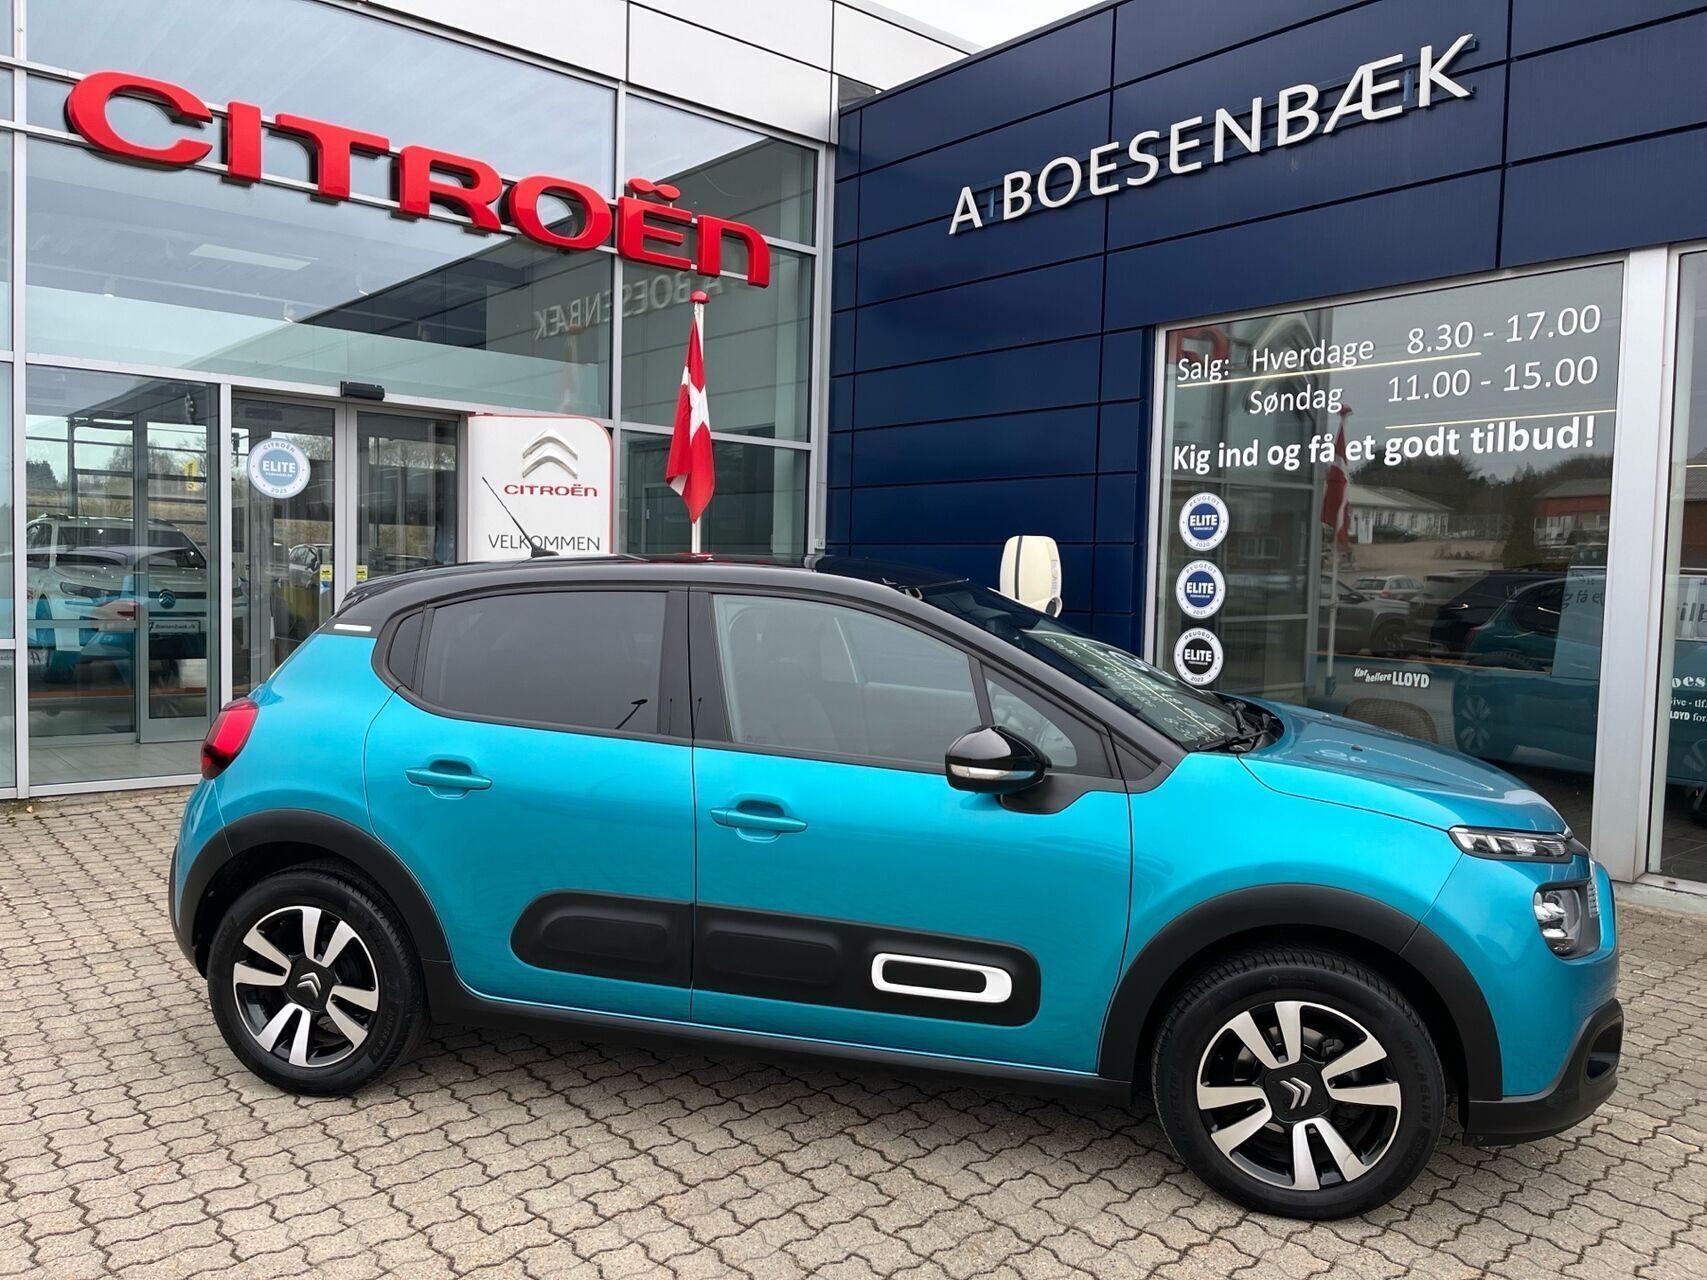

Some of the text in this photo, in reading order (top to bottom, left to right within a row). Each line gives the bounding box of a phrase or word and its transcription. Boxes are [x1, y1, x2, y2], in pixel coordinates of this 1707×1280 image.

[948, 33, 1474, 235] A BOESENBÆK
[66, 71, 771, 288] CITROËN
[1177, 354, 1230, 382] Salg:
[1252, 339, 1375, 373] Hverdage
[1406, 321, 1474, 354] 8.30
[1506, 304, 1601, 343] 17.00
[1249, 384, 1343, 415] Søndag
[1387, 369, 1472, 402] 11.00
[1503, 355, 1599, 392] 15.00
[1173, 415, 1595, 475] Kig ind og få et godt tilbud!
[262, 460, 296, 473] ELITE
[1189, 496, 1220, 507] PEUGEOT
[1190, 514, 1218, 526] ELITE
[488, 534, 600, 551] VELKOMMEN
[1186, 564, 1216, 574] PEUGEOT
[1186, 582, 1214, 594] ELITE
[1185, 631, 1214, 641] PEUGEOT
[1184, 649, 1212, 662] ELITE
[1392, 671, 1430, 688] LLOYD
[1671, 697, 1687, 706] ive
[1693, 713, 1707, 722] for
